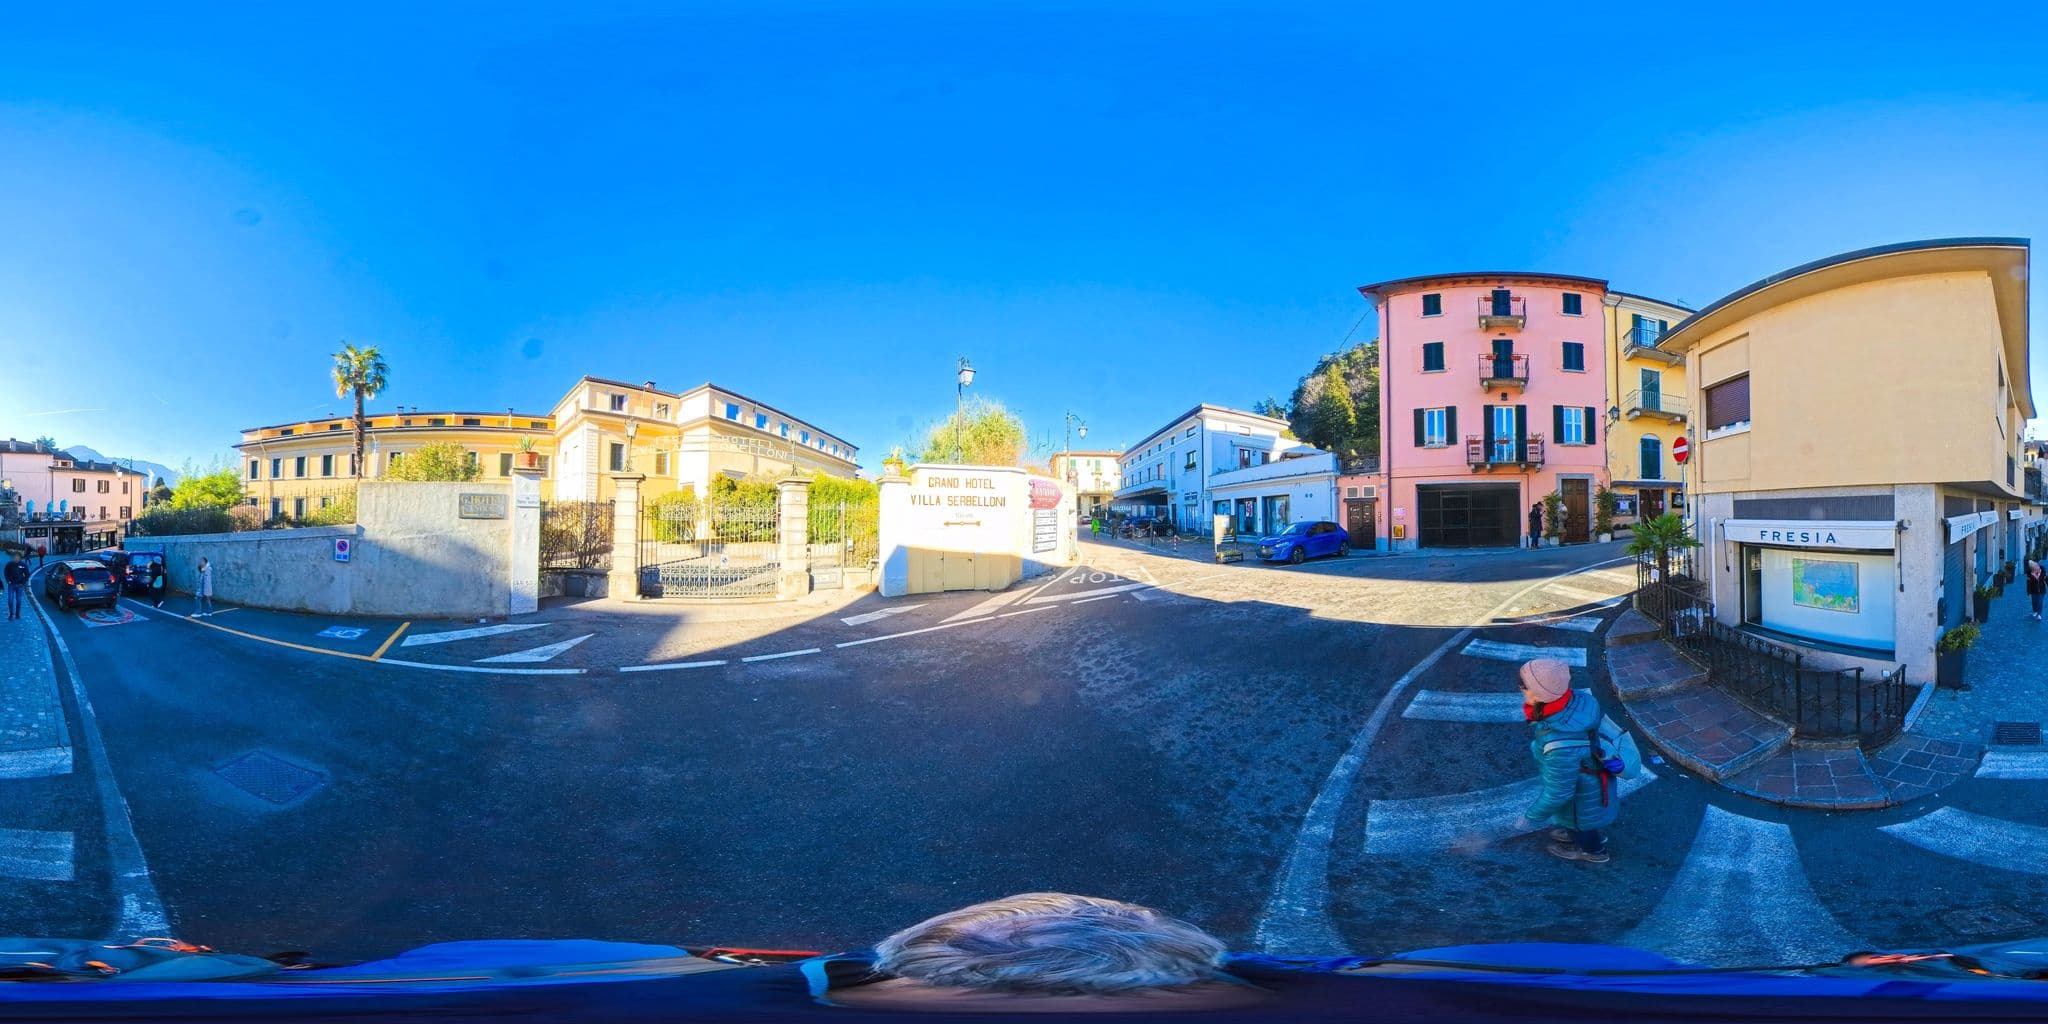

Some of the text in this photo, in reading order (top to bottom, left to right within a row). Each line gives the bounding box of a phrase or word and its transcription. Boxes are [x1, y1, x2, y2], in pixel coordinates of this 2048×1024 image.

[928, 476, 996, 490] GRAND HOTEL
[910, 494, 1006, 508] VILLA SERBELLONI
[1760, 530, 1837, 544] FRESIA
